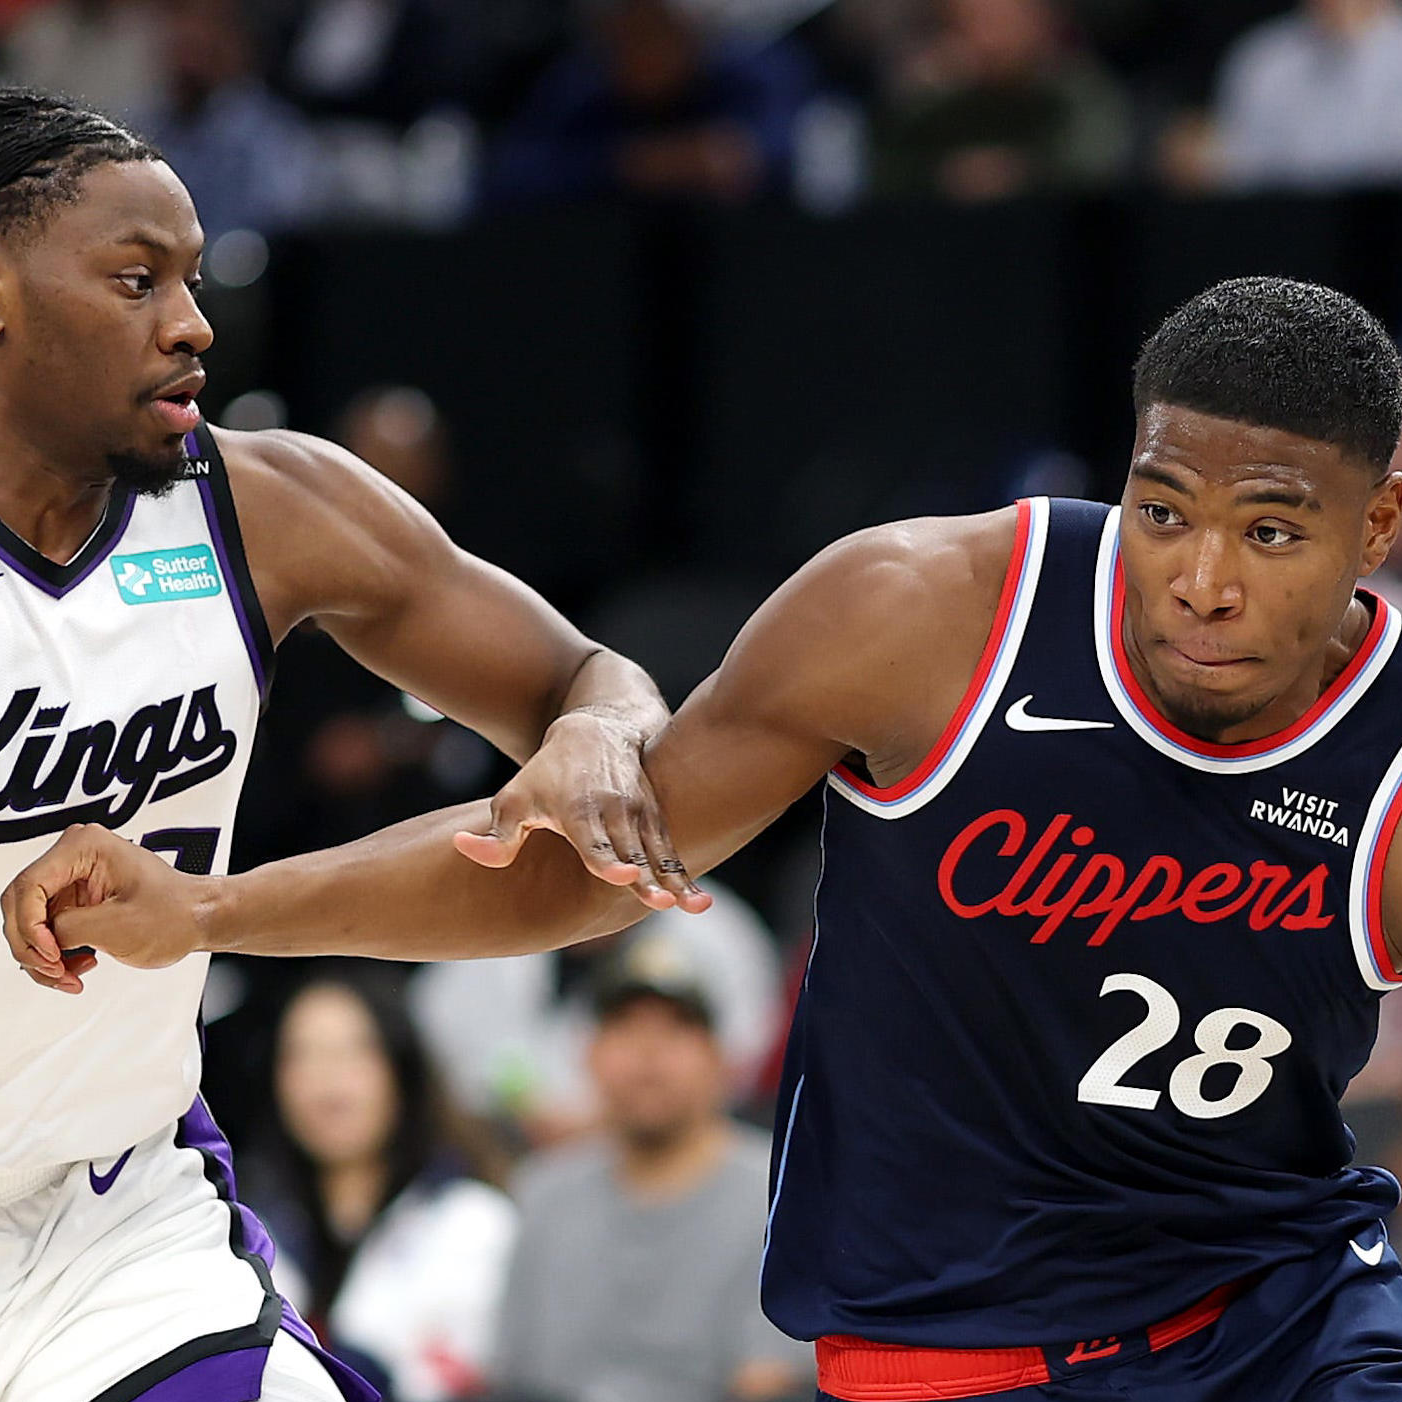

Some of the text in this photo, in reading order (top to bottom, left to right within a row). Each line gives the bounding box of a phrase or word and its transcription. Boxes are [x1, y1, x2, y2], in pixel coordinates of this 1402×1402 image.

[152, 555, 208, 576] Sutter
[158, 572, 217, 593] Health
[1282, 787, 1339, 819] VISIT
[1250, 799, 1349, 848] RWANDA
[937, 808, 1337, 947] Clippers
[1077, 972, 1293, 1120] 28
